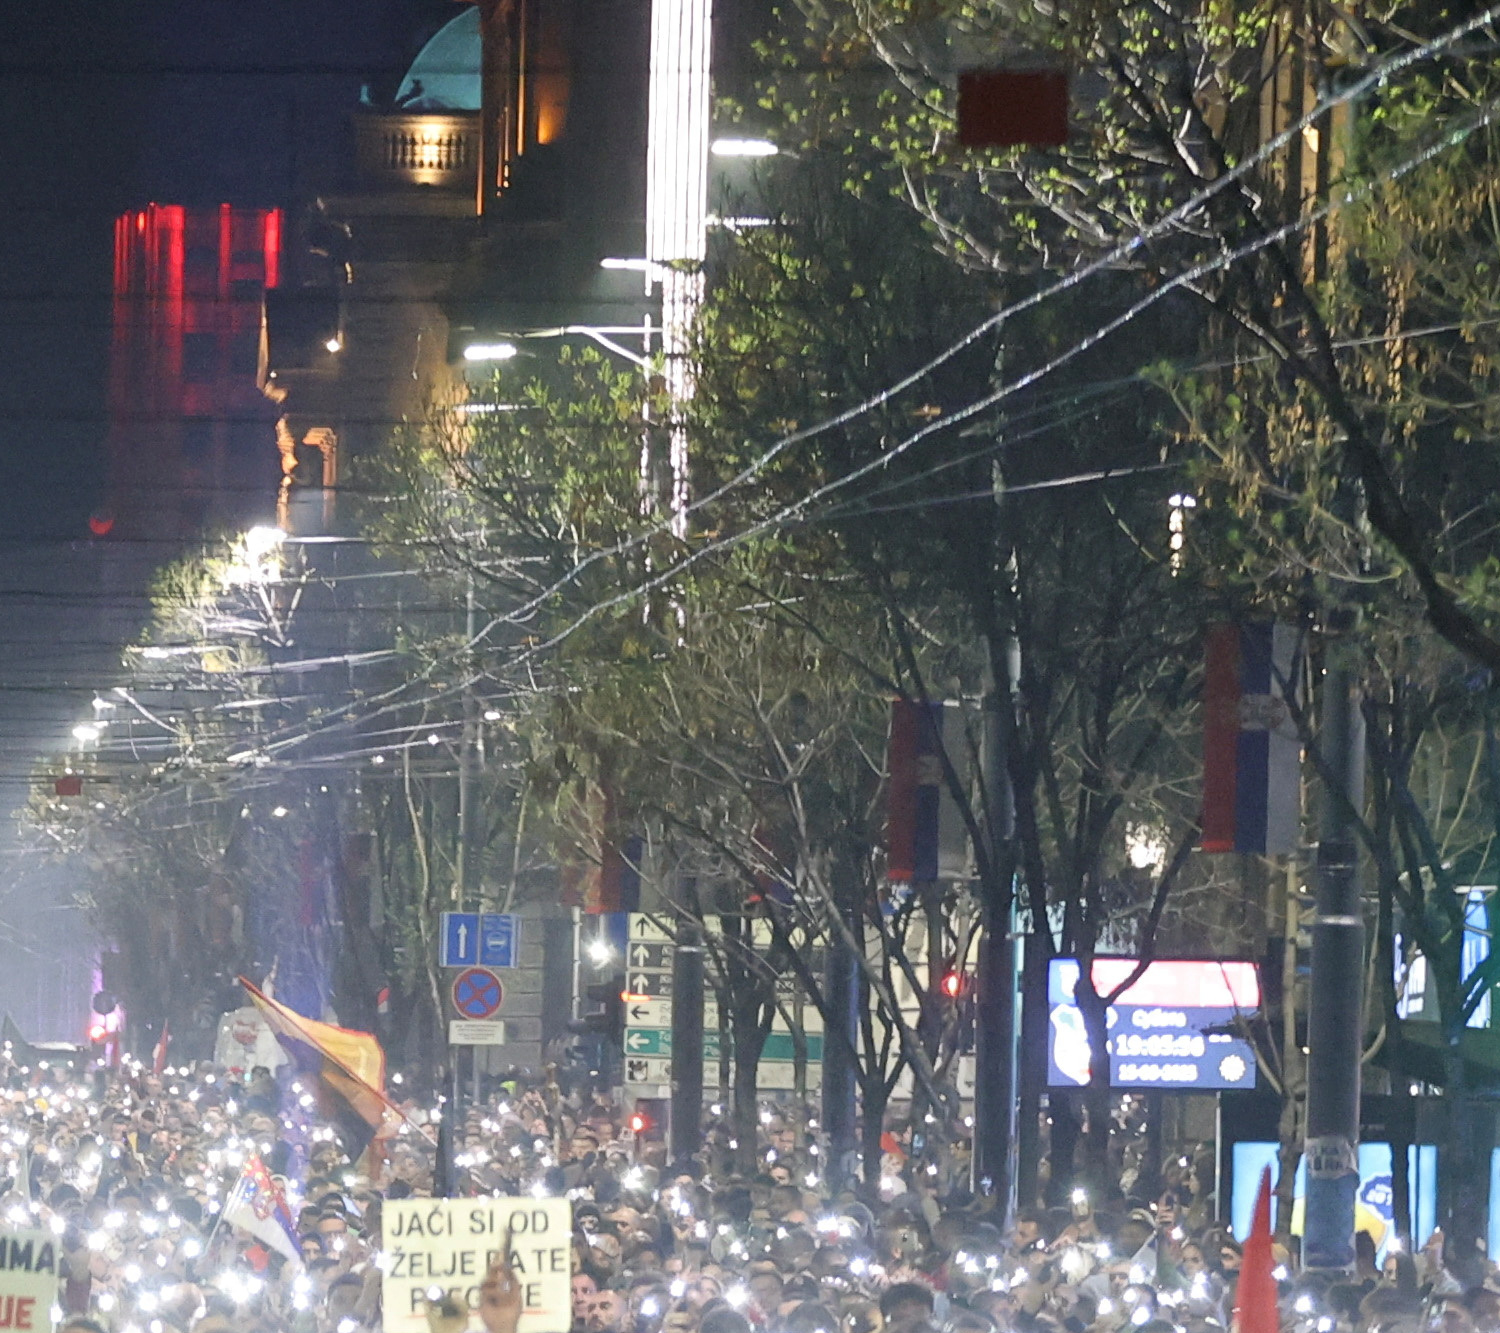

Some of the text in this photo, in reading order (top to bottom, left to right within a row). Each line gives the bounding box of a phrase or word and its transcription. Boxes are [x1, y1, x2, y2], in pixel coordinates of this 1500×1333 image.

[469, 1209, 494, 1235] SI
[509, 1209, 549, 1235] OD
[389, 1246, 477, 1279] ŽELJE
[532, 1248, 567, 1273] TE
